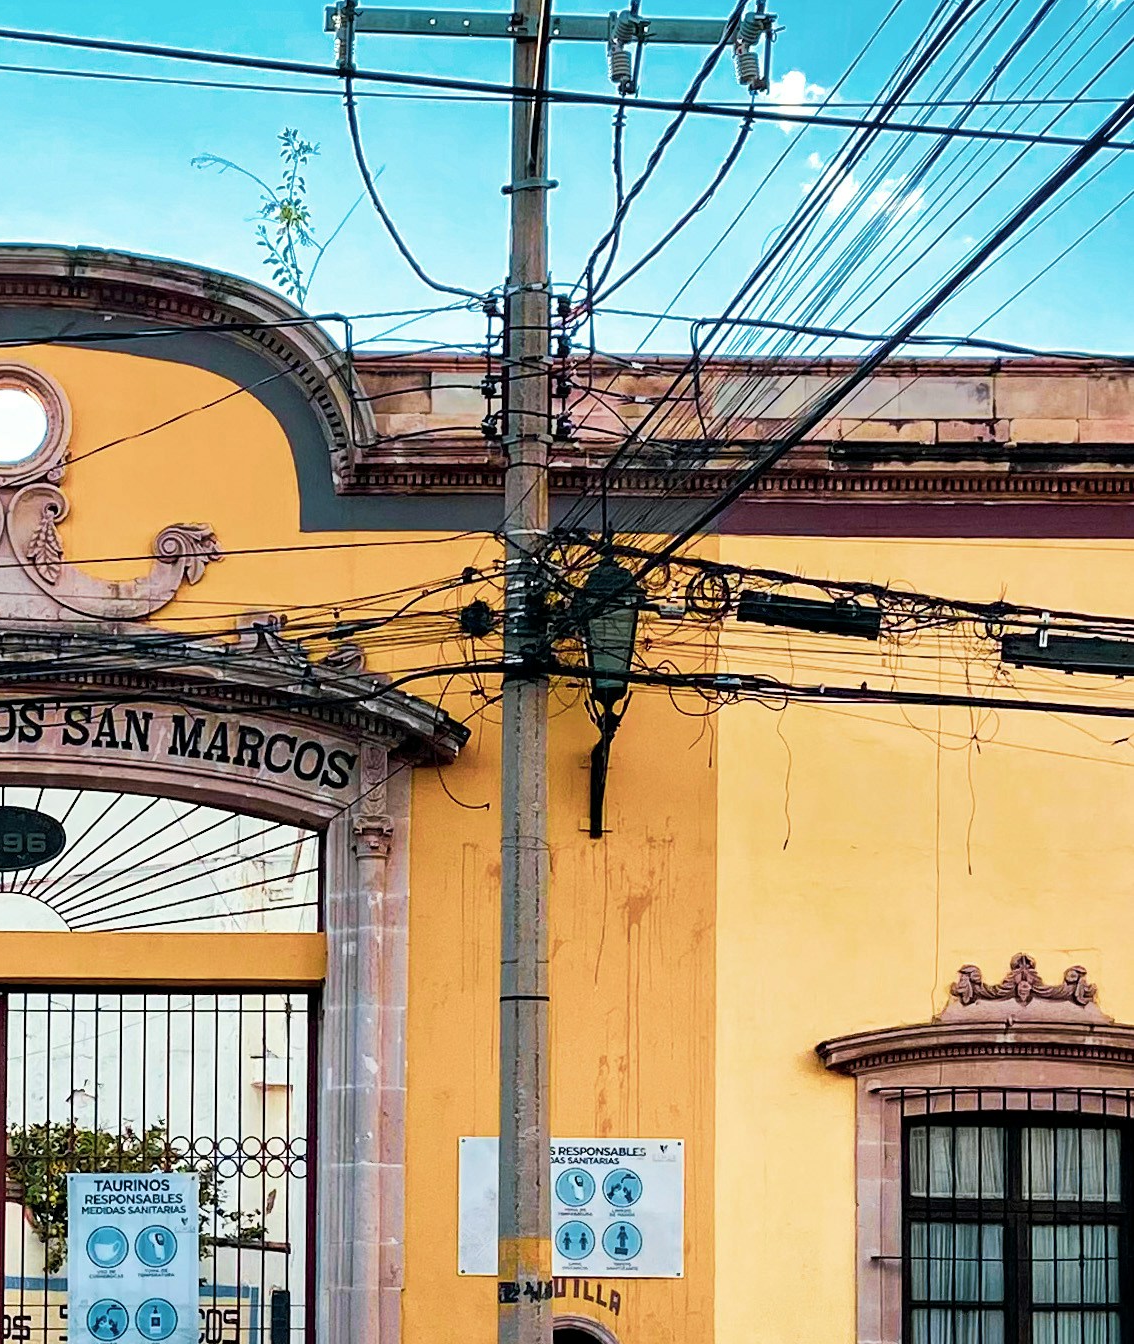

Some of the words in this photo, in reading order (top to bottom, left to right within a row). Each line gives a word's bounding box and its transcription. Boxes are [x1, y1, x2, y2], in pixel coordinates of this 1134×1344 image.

[62, 705, 154, 752] SAN
[168, 714, 360, 789] MARCOS
[558, 1146, 646, 1156] RESPONSABLES
[567, 1157, 620, 1165] SANITARIAS
[94, 1179, 170, 1192] TAURINOS
[85, 1194, 183, 1204] RESPONSABLES
[82, 1206, 126, 1214] MEDIDAS
[128, 1205, 186, 1214] SANITARIAS
